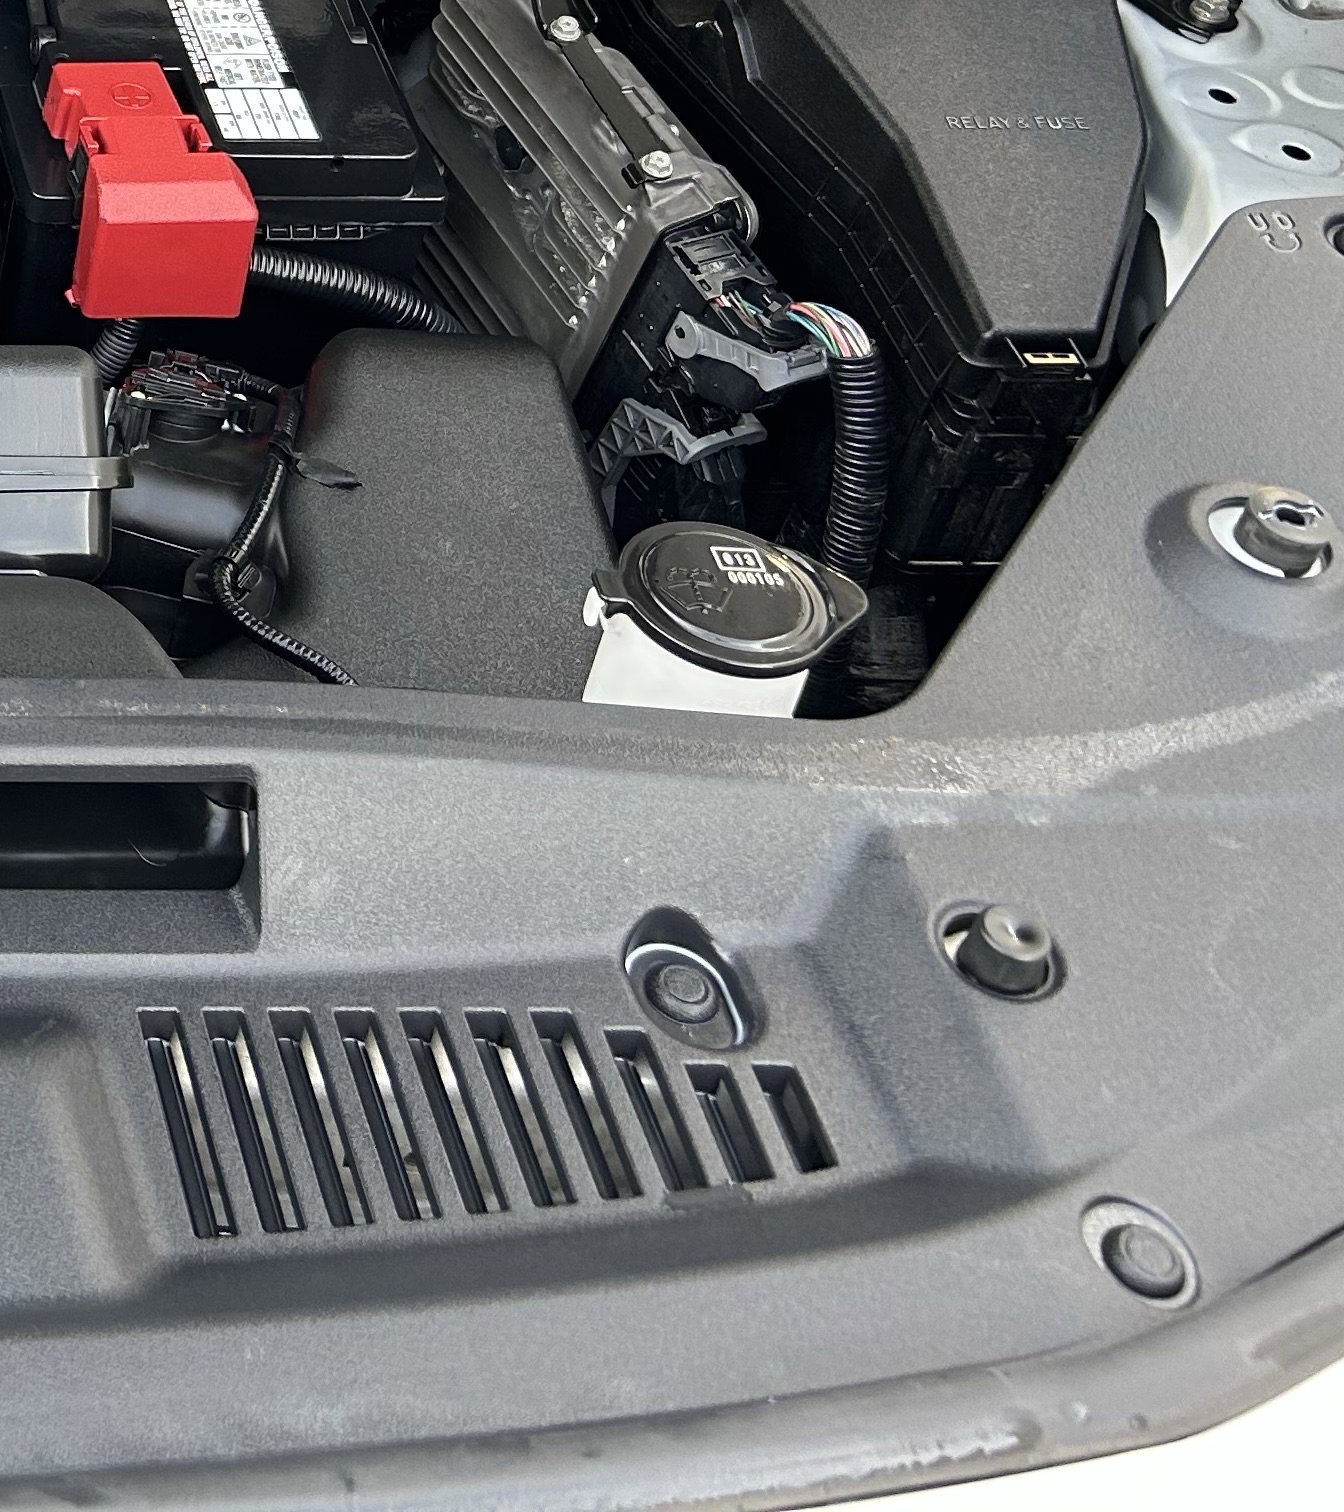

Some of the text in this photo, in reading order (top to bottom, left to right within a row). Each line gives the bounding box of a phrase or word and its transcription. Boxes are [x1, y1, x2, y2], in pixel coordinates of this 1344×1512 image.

[945, 115, 1092, 131] RELAY & FUSE
[728, 571, 785, 586] 000105
